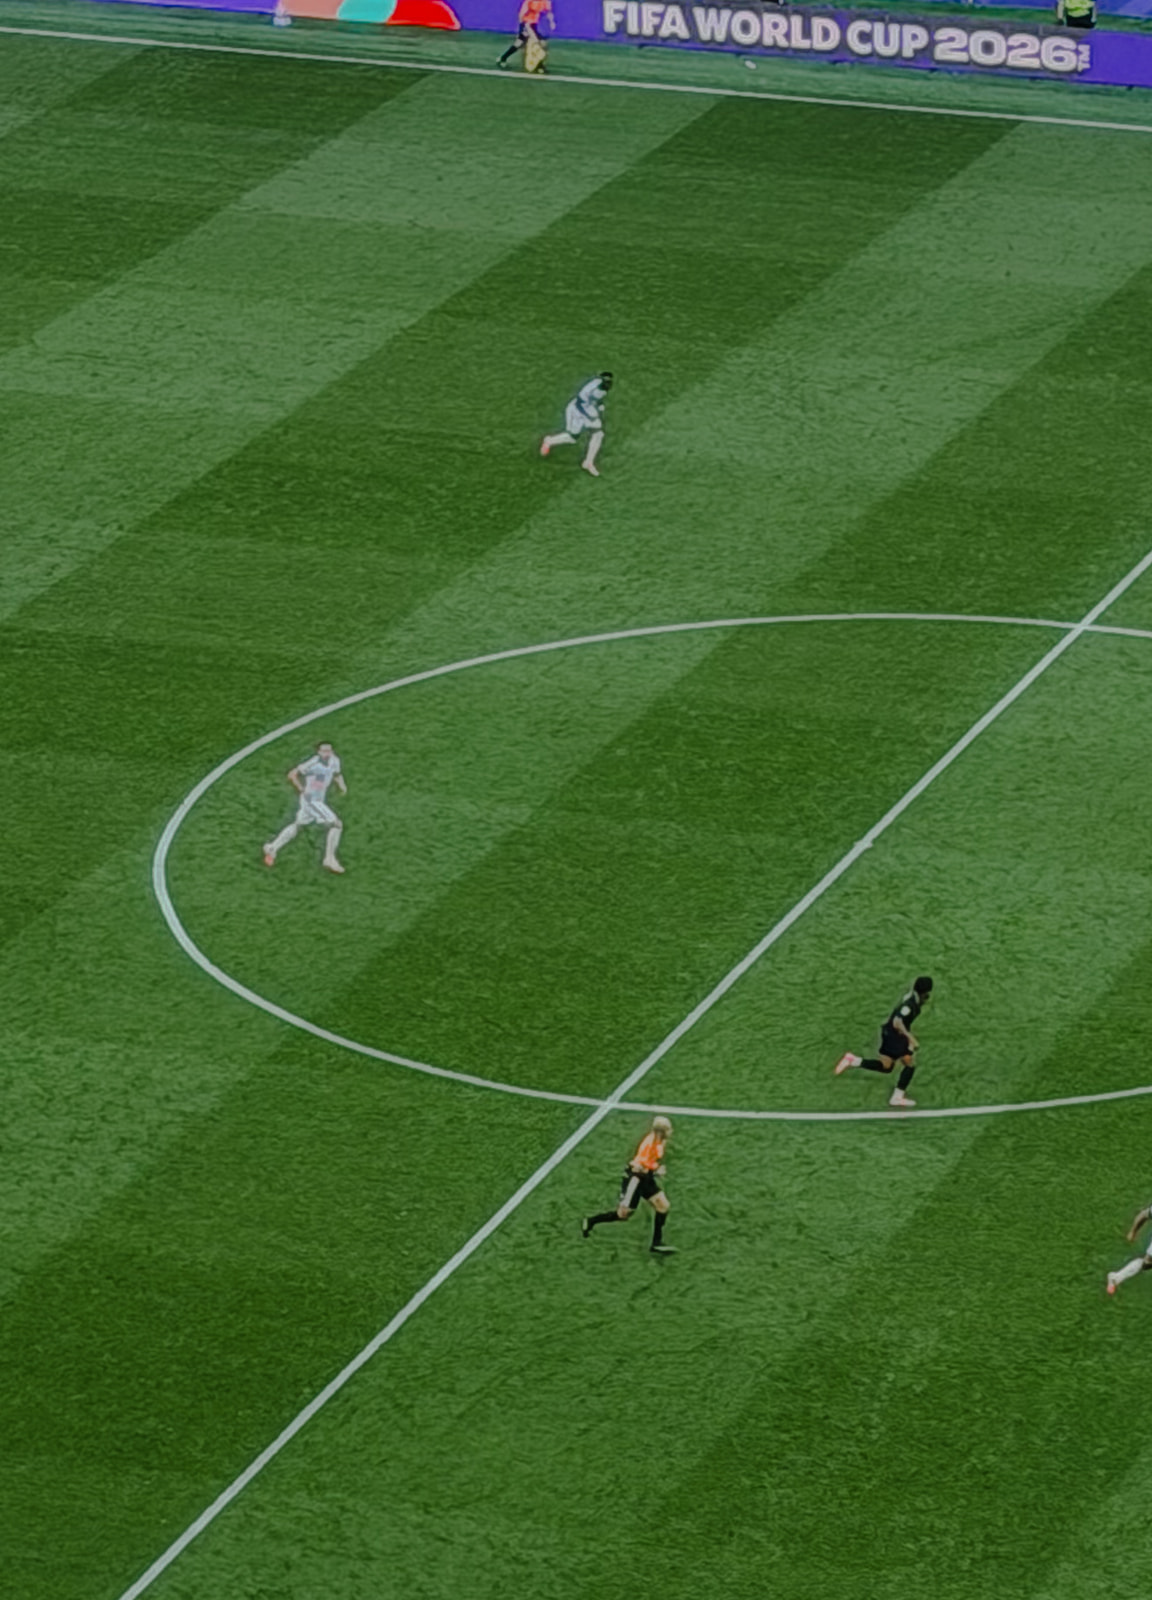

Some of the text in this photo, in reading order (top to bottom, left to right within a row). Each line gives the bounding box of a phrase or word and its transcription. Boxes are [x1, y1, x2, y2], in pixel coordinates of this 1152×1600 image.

[603, 0, 691, 40] FIFA
[692, 6, 841, 50] WORLD
[846, 19, 930, 58] CUP
[933, 27, 1078, 72] 2026
